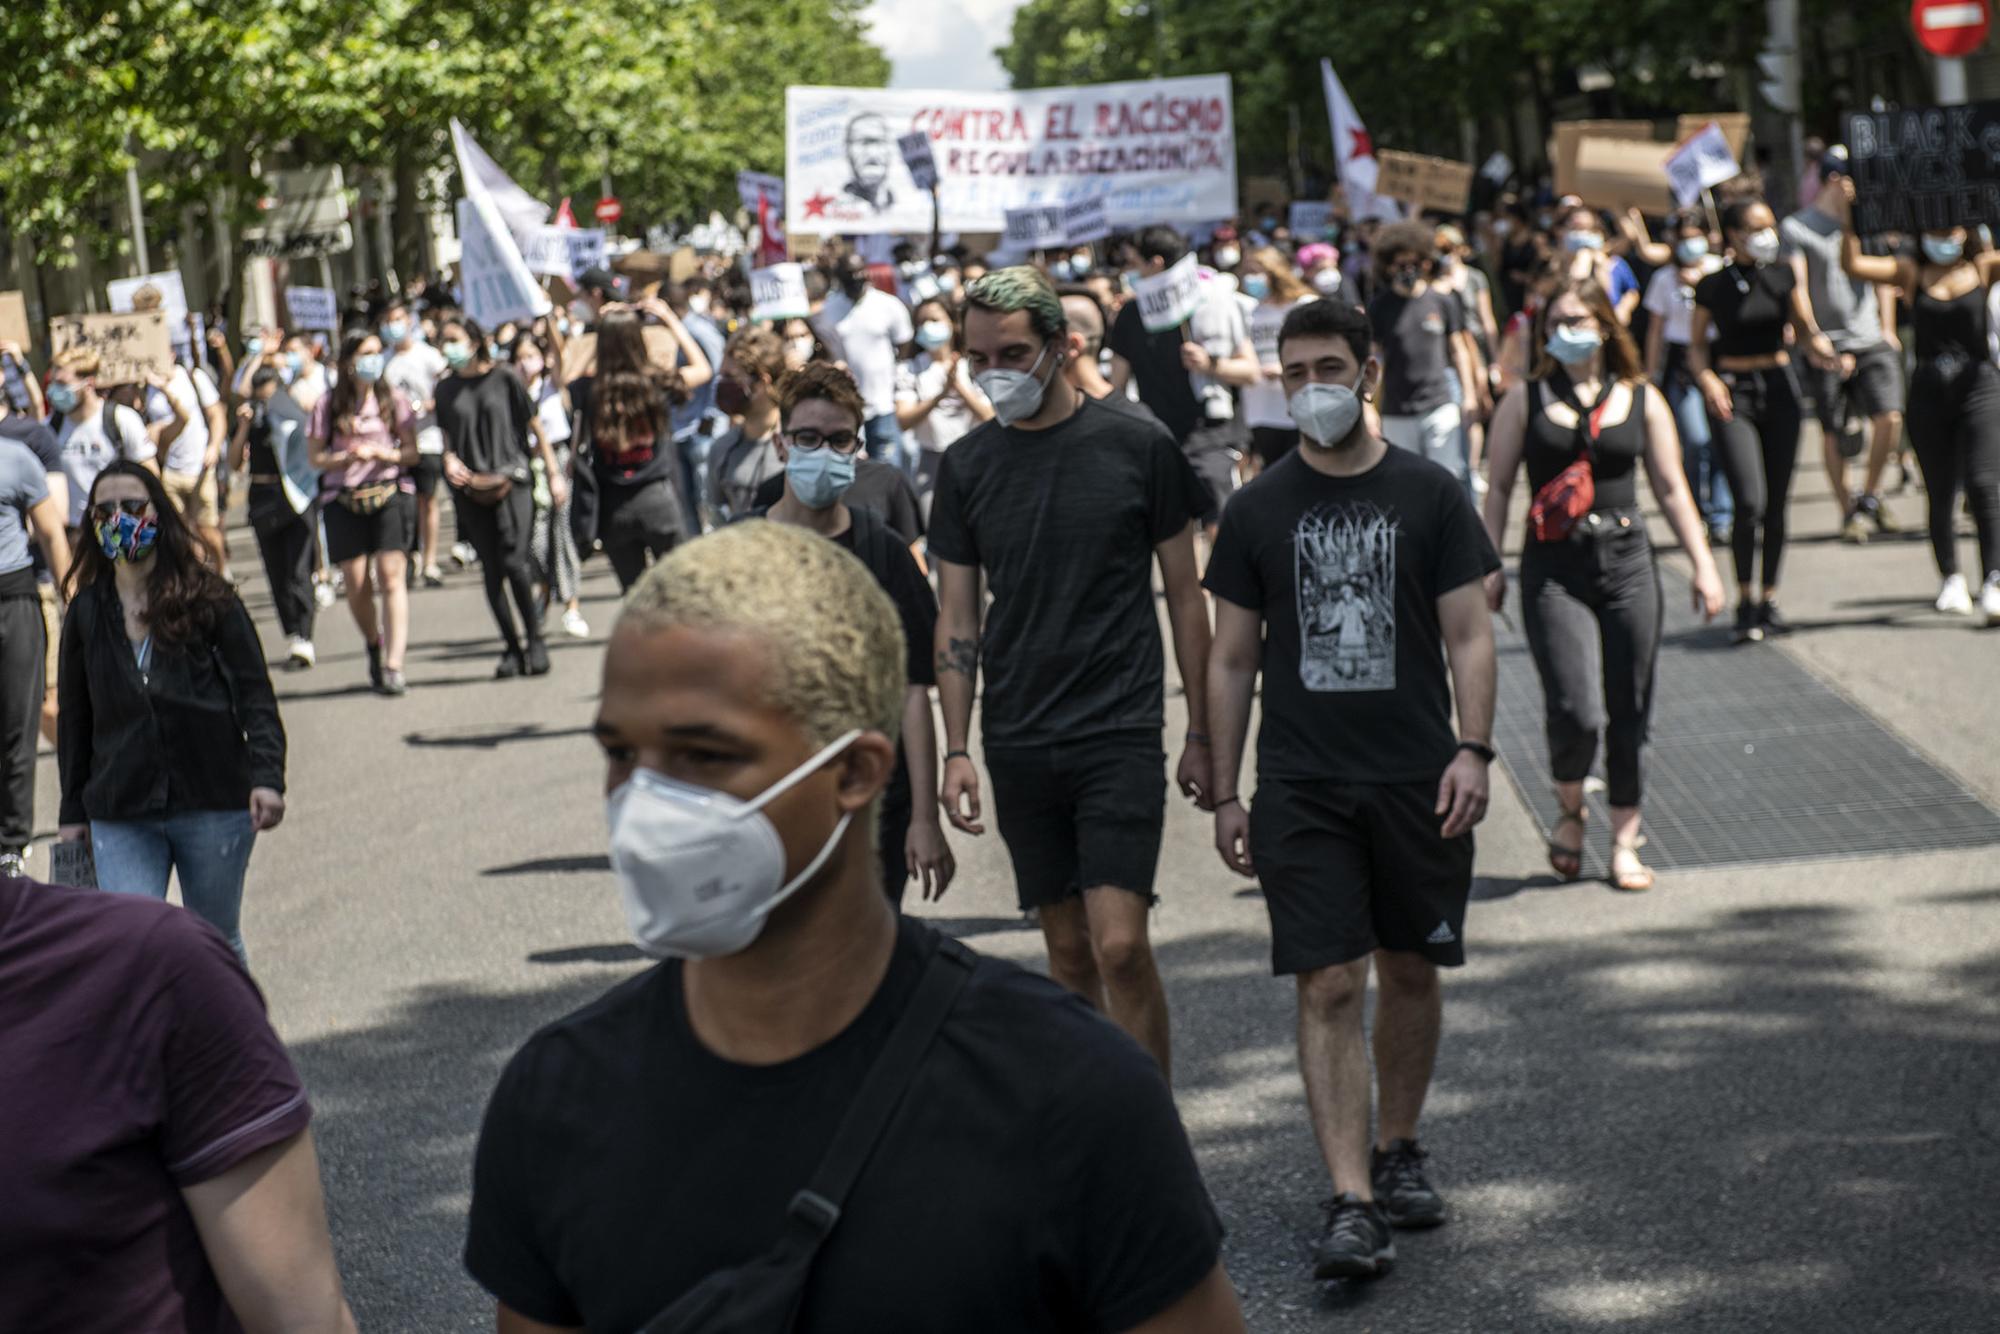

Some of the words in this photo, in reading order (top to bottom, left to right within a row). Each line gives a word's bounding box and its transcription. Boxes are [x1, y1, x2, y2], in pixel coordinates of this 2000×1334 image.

[911, 104, 1030, 141] CONTRA
[1045, 102, 1081, 140] EL
[1850, 106, 1978, 160] BLACK
[1855, 151, 1968, 194] LIVES
